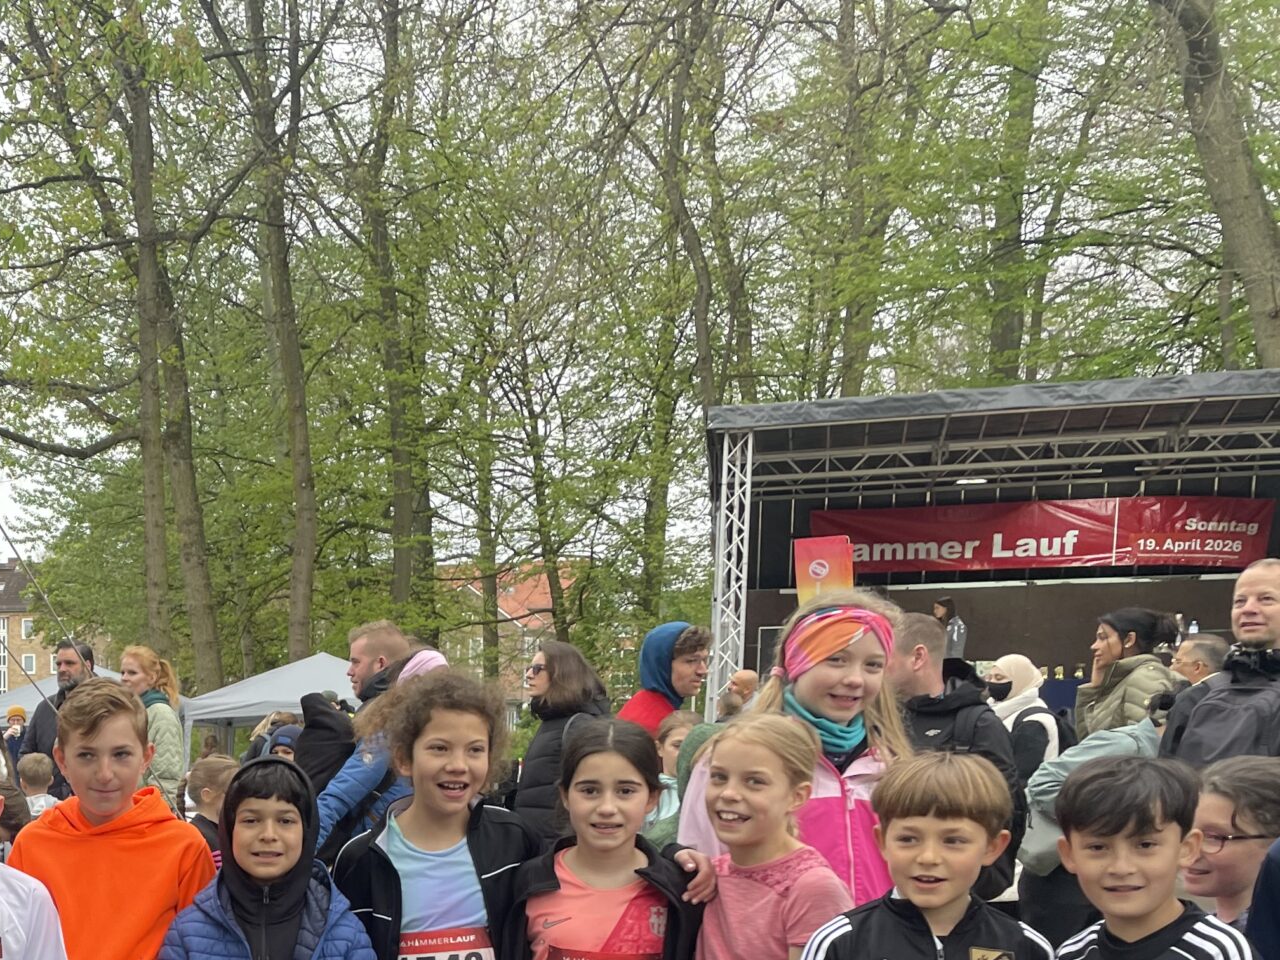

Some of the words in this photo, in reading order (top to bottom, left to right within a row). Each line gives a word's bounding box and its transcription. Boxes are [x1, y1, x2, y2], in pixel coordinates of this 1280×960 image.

[1185, 517, 1259, 535] Sonntag
[992, 530, 1079, 558] Lauf
[1137, 538, 1160, 551] 19.
[1162, 538, 1201, 552] April
[1204, 539, 1242, 552] 2026
